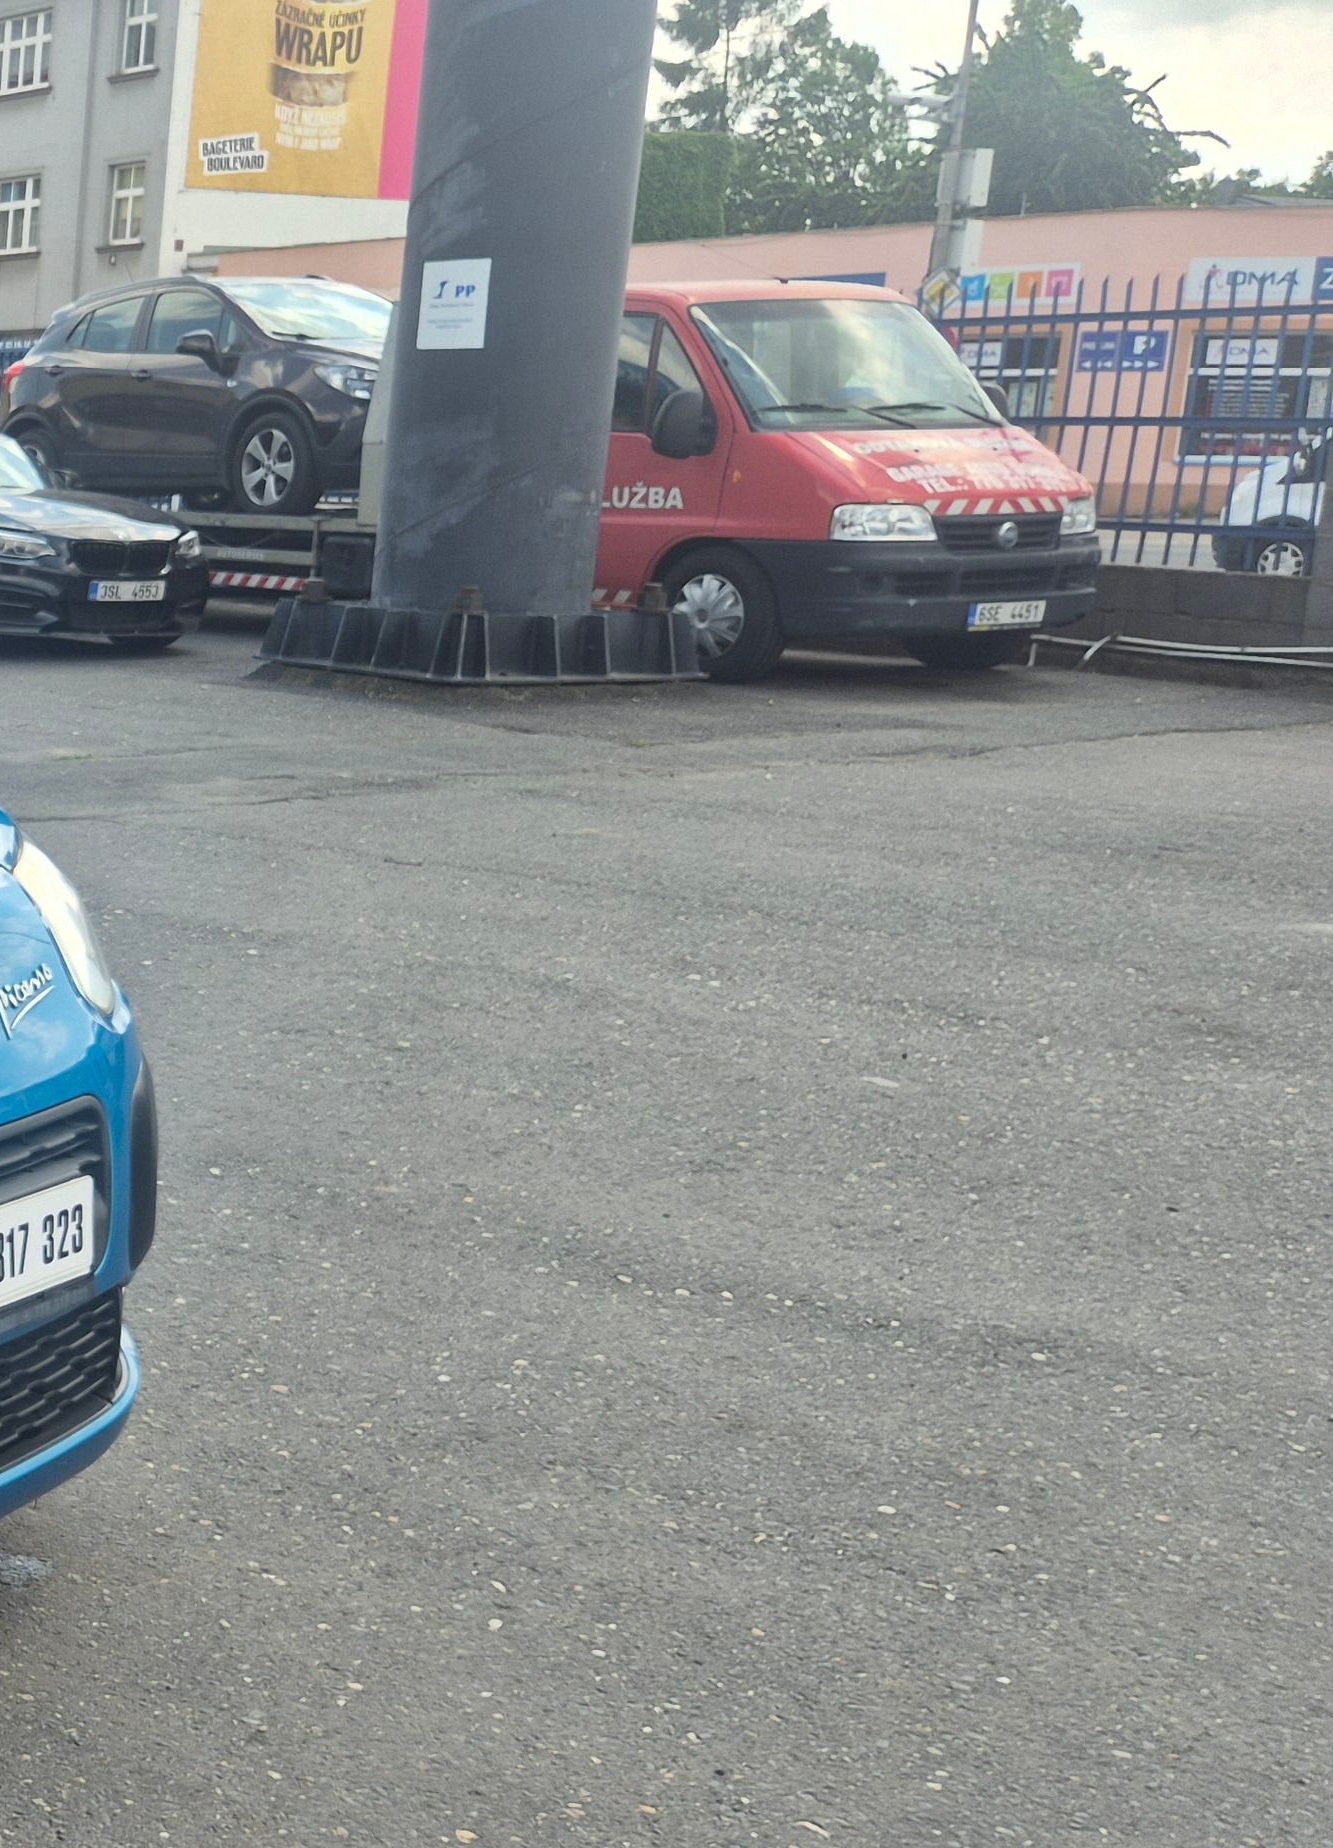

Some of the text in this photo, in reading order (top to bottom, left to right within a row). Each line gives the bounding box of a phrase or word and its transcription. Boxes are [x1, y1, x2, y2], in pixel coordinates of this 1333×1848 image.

[275, 17, 364, 67] WRAPU
[202, 136, 255, 157] BAGETERIE
[207, 154, 265, 172] BOULEVARD
[42, 1203, 83, 1264] 323
